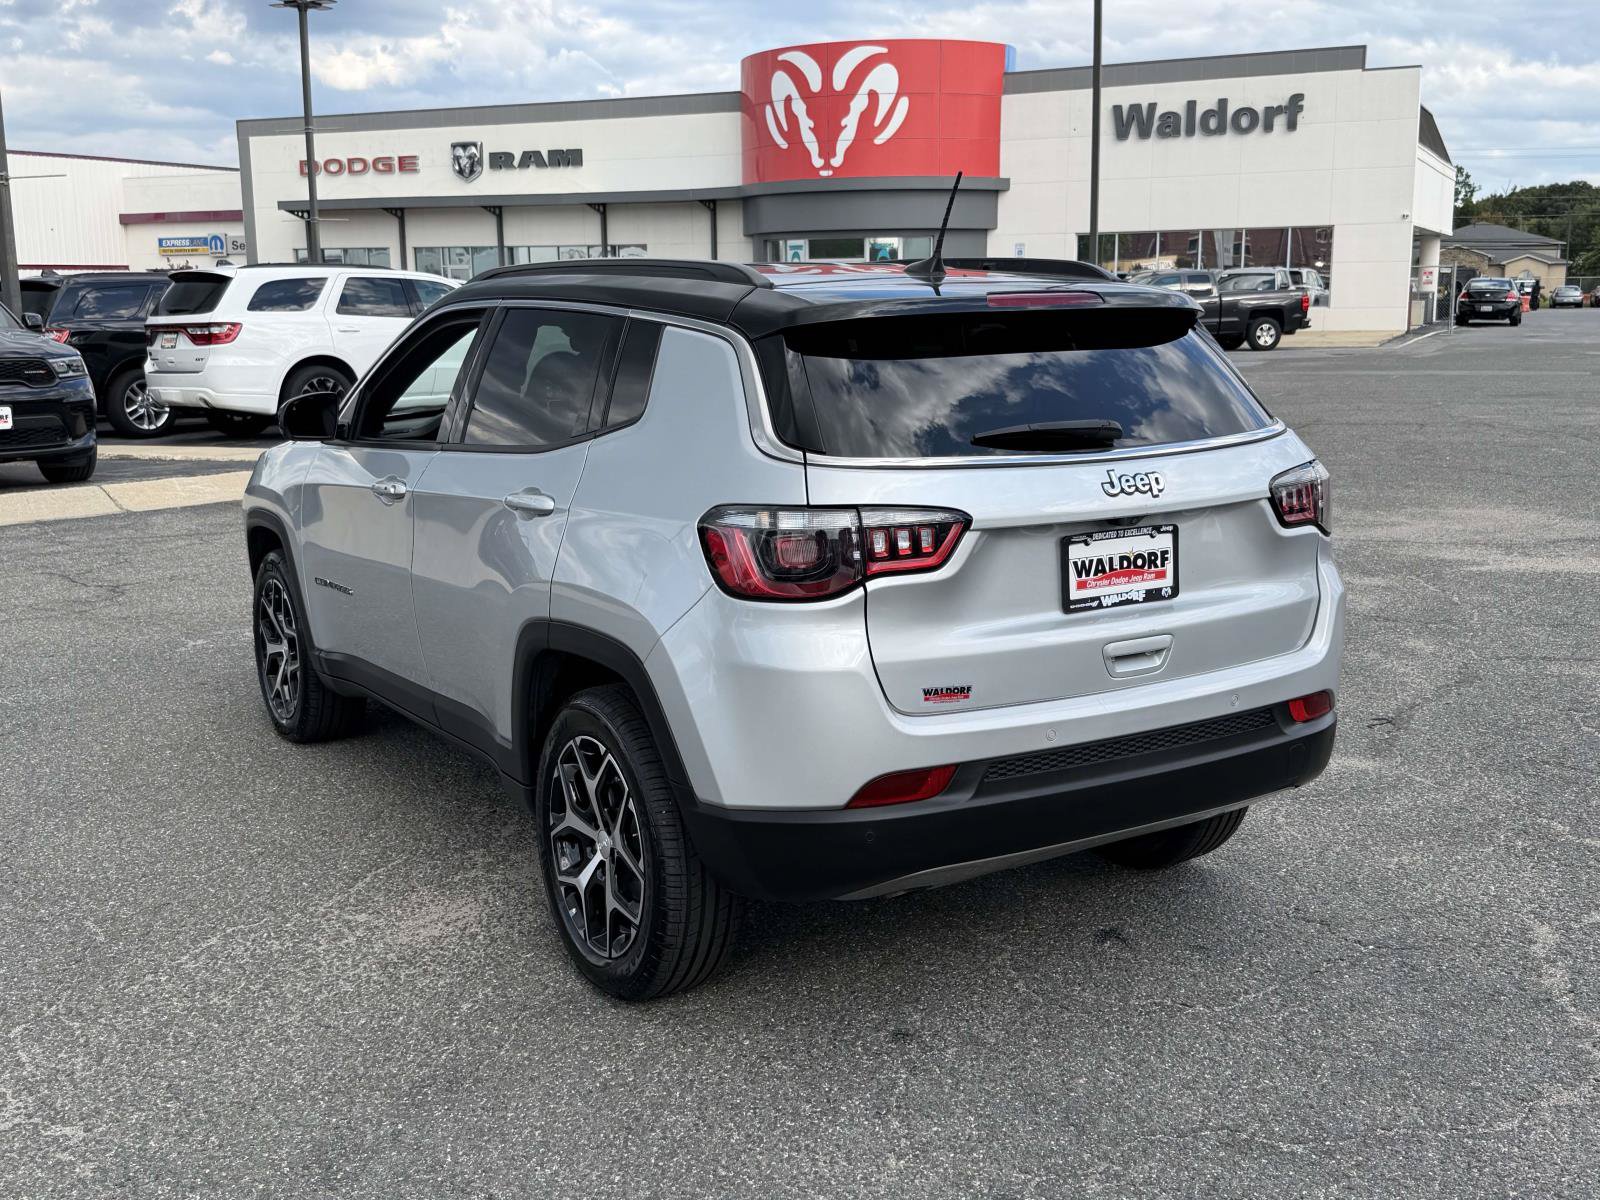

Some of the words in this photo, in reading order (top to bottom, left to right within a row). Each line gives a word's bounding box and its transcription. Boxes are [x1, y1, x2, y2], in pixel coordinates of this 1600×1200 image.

[1112, 93, 1304, 140] Waldorf
[299, 155, 419, 177] DODGE
[489, 149, 583, 171] RAM
[162, 239, 190, 247] EXPRESS
[231, 240, 246, 251] Se
[1101, 469, 1165, 498] Jeep
[1092, 530, 1117, 540] DEDICATED
[1117, 529, 1124, 537] TO
[1124, 526, 1153, 537] EXCELLENCE
[1072, 549, 1169, 579] WALDORF
[1086, 578, 1110, 588] Chrysler
[1110, 576, 1129, 585] Dodge
[1129, 574, 1143, 583] Jeep
[1143, 572, 1156, 580] Ram
[1101, 590, 1146, 606] WALDORF
[922, 686, 972, 697] WALDORF
